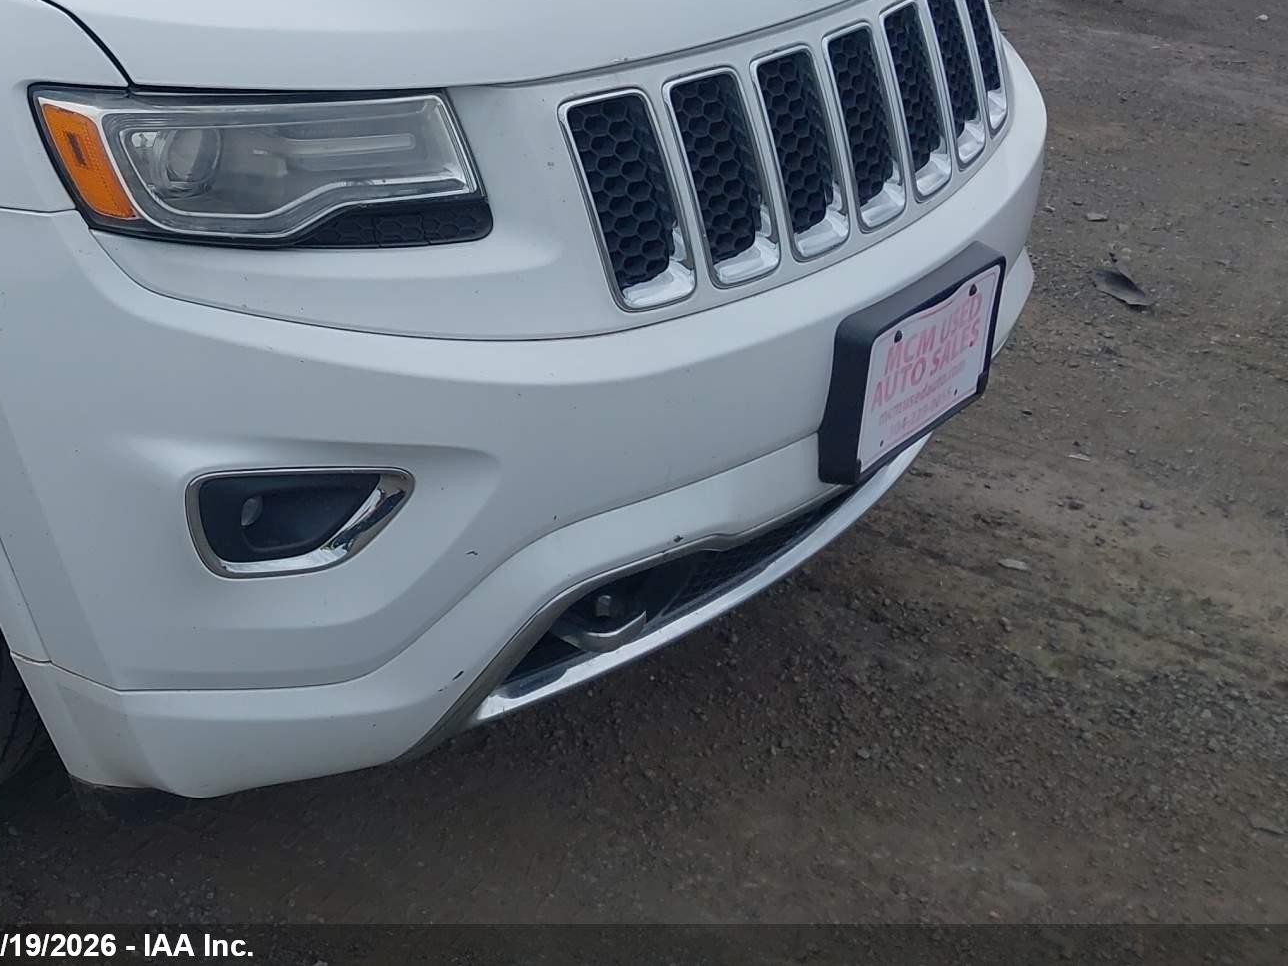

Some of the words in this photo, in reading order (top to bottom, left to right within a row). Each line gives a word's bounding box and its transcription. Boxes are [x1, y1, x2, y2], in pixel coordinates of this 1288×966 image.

[870, 357, 926, 411] AUTO
[930, 320, 981, 376] SALES
[883, 324, 936, 376] MCM
[940, 294, 983, 343] USED
